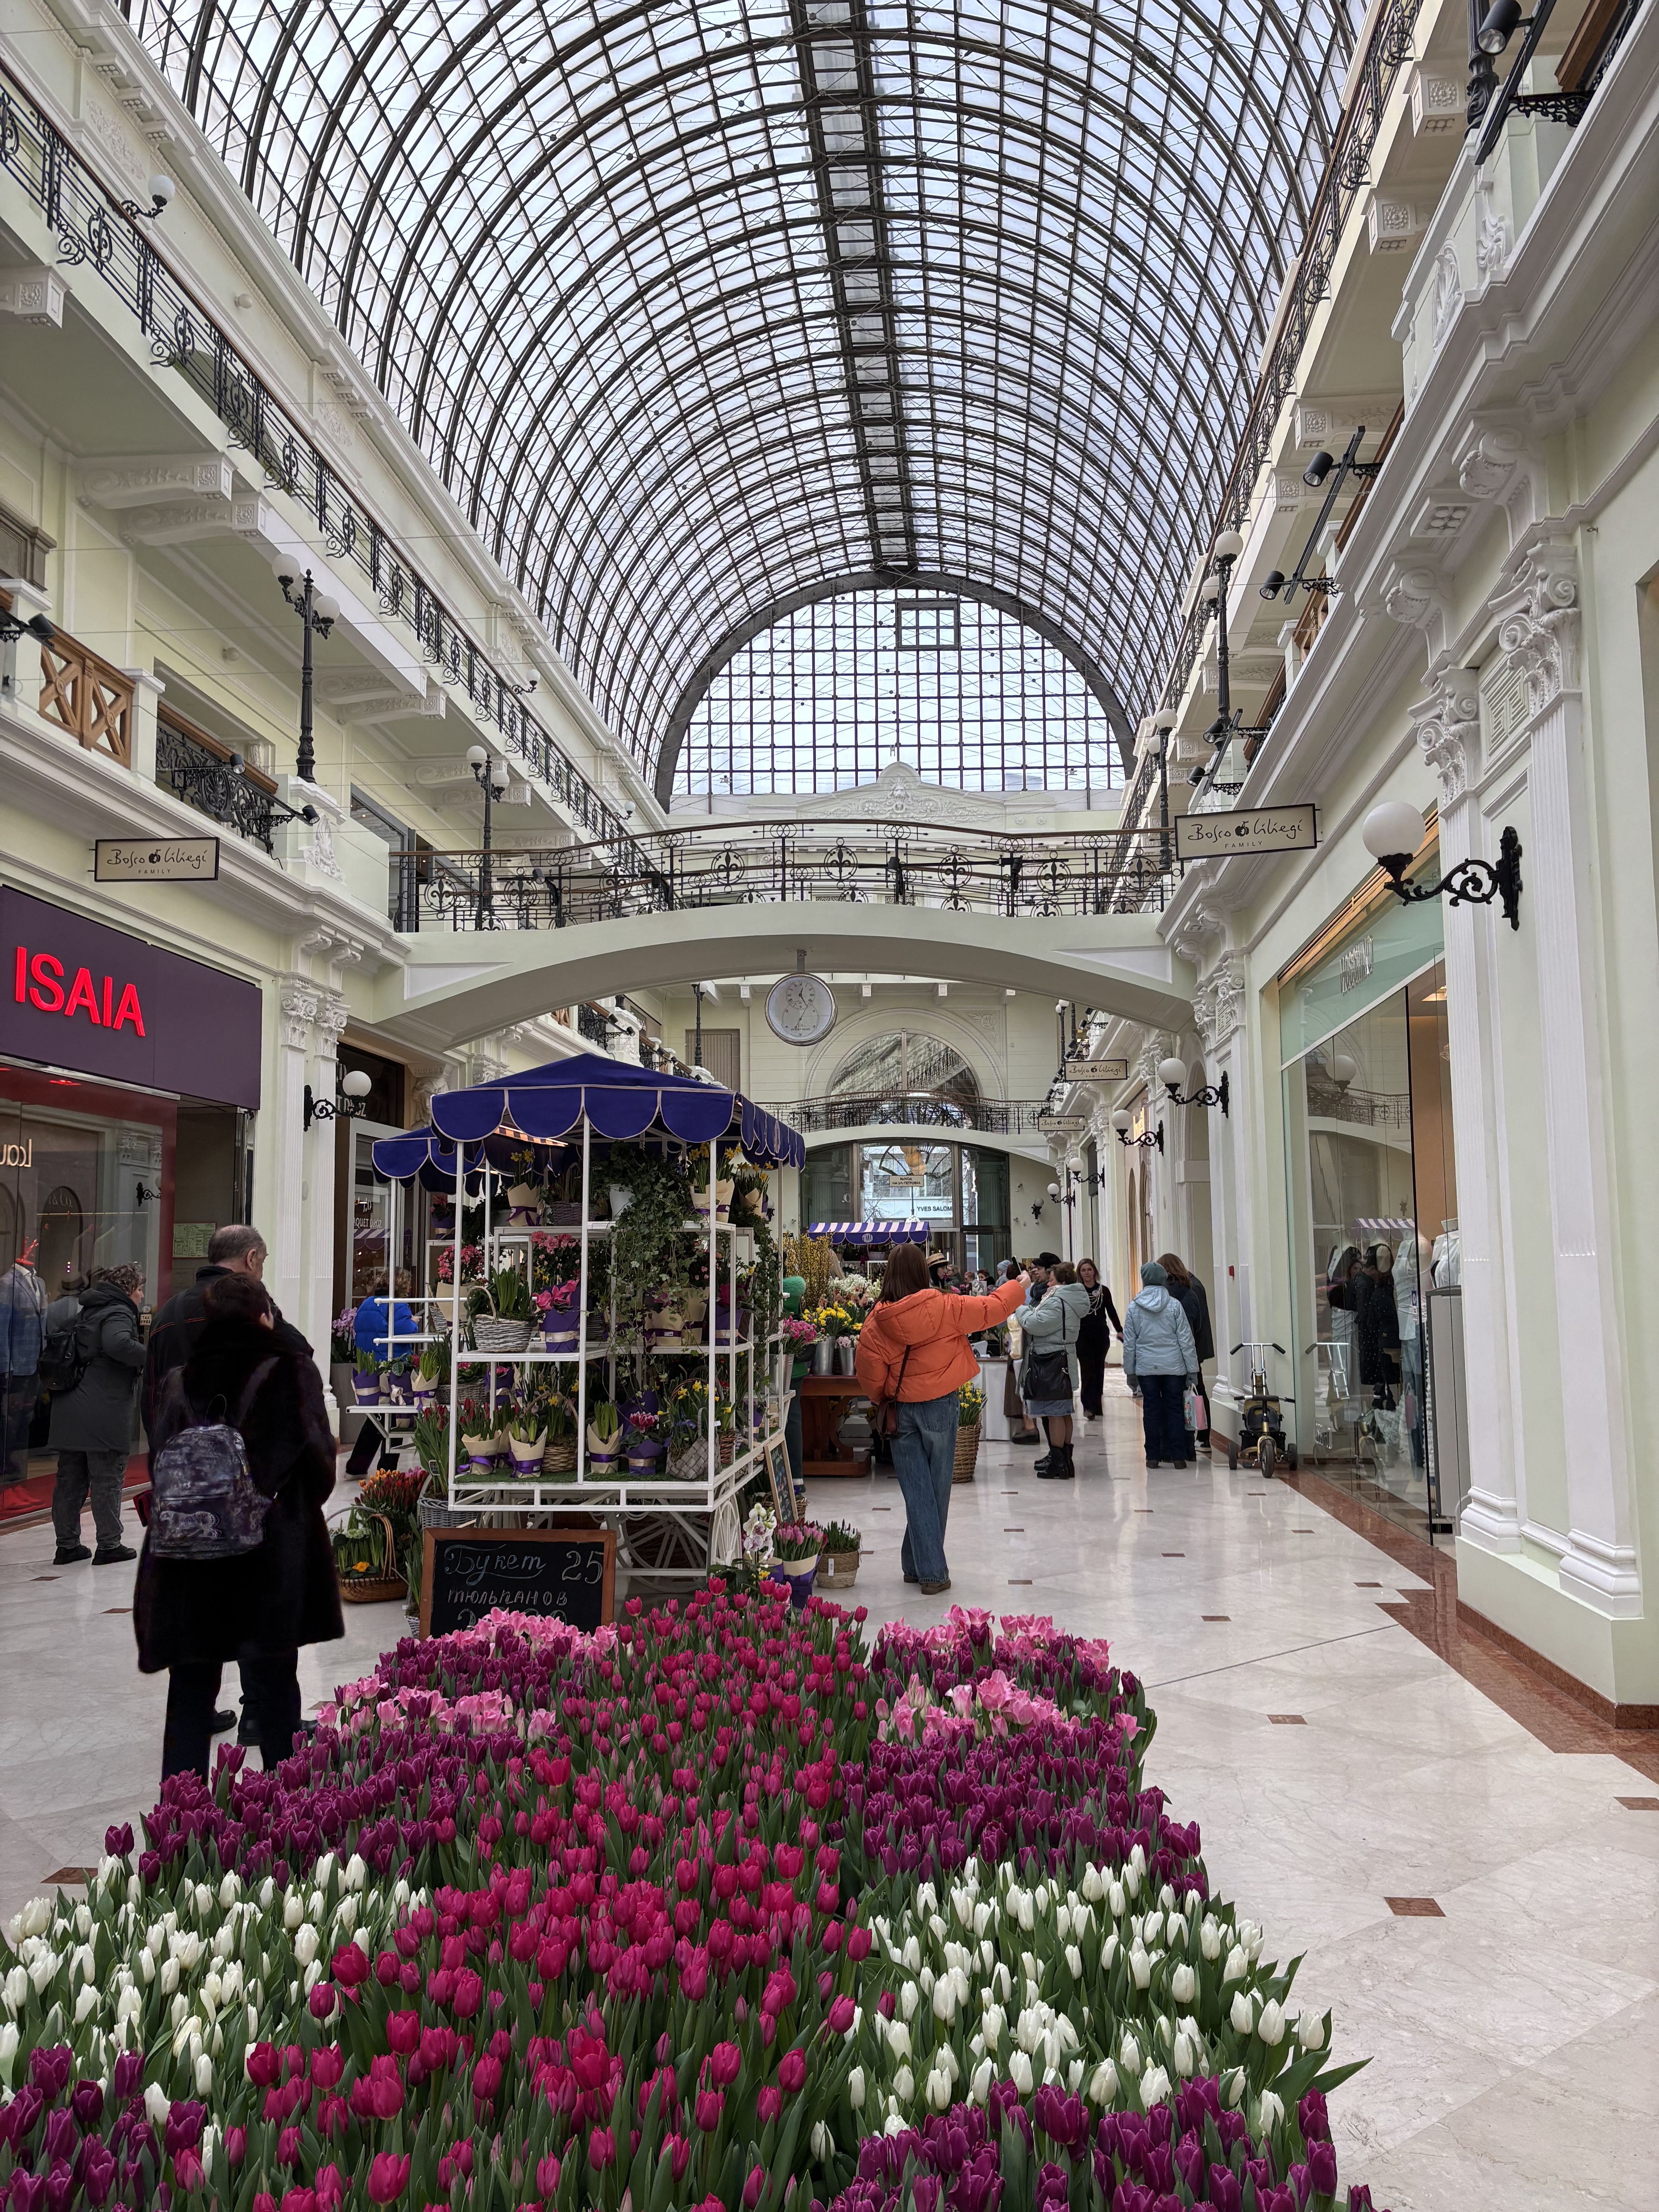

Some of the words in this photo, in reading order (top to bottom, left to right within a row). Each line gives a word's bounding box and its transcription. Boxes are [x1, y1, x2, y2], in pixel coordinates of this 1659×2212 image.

[1188, 824, 1231, 843] Bosco
[106, 849, 145, 868] Bosco
[15, 946, 146, 1037] ISAIA
[1069, 1065, 1089, 1075] Bosco
[370, 1219, 382, 1228] DROZ
[444, 1544, 546, 1586] Букет
[562, 1550, 604, 1584] 25
